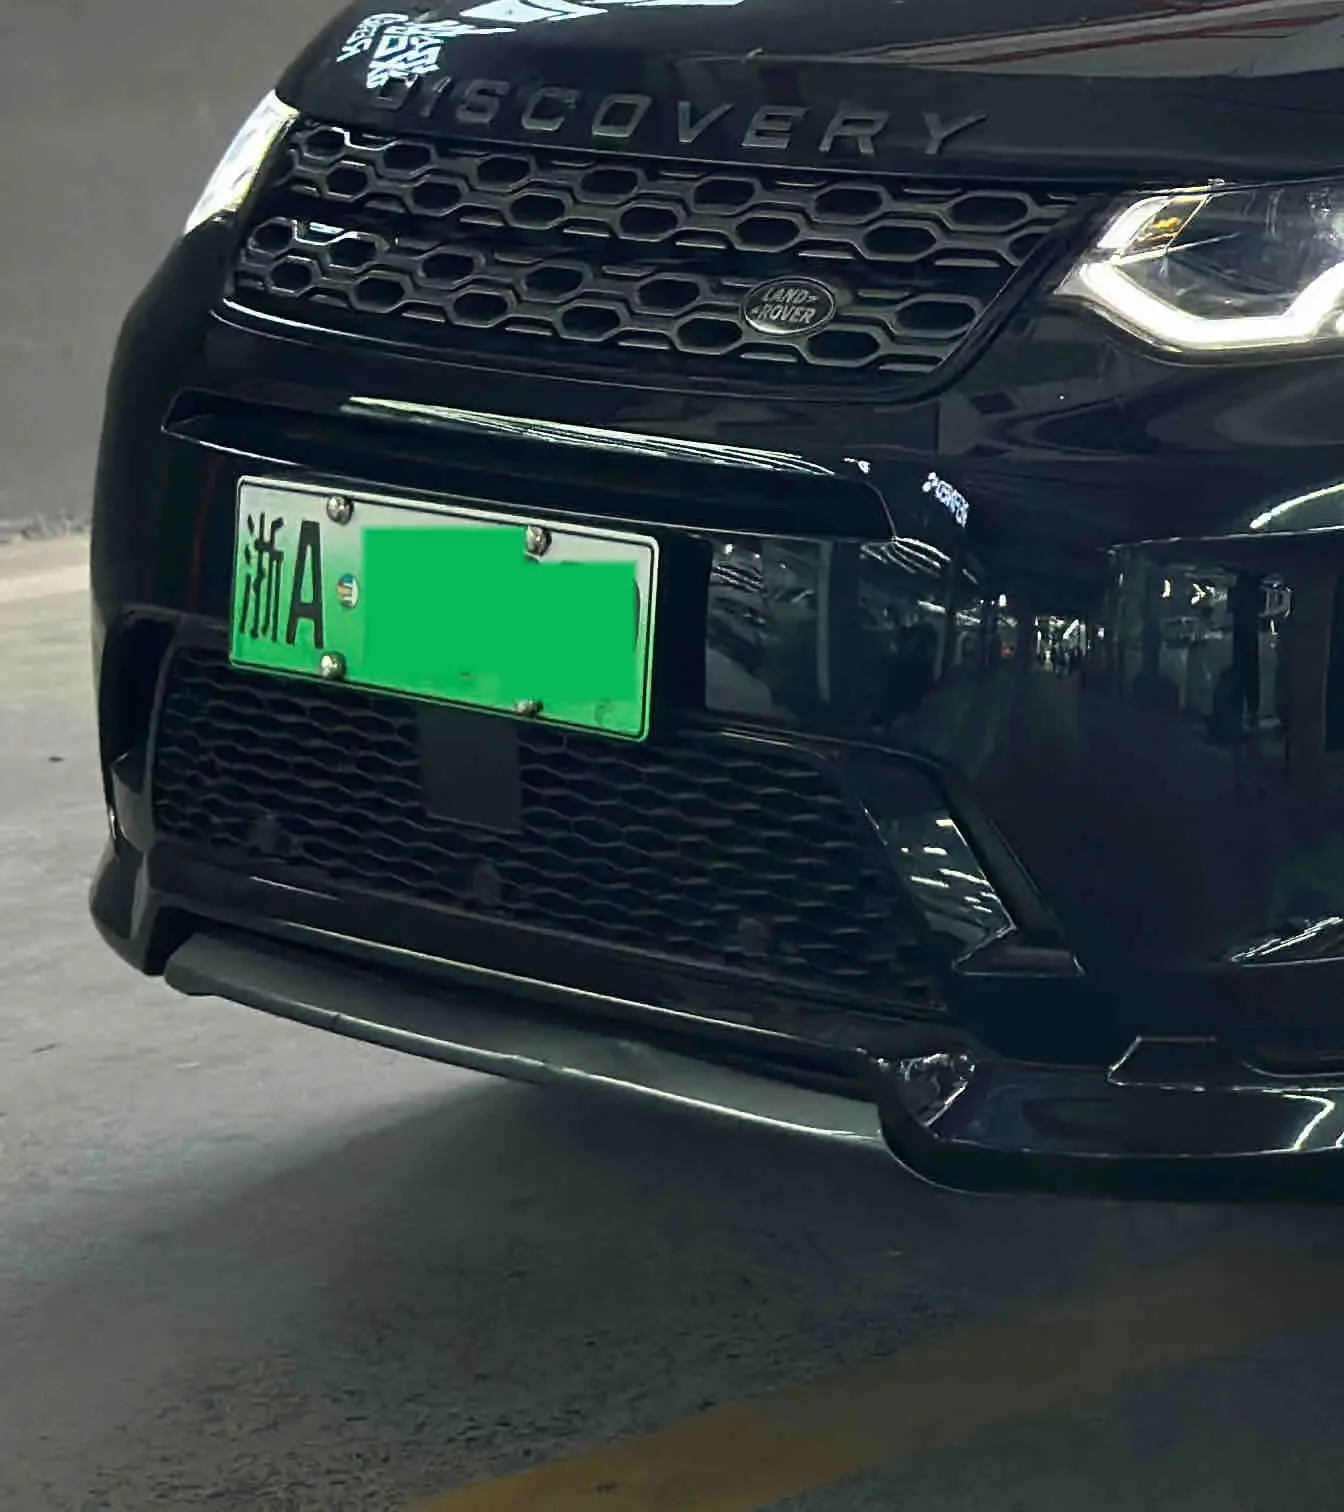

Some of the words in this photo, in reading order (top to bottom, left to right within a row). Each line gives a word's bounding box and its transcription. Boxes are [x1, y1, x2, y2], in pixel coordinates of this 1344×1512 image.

[368, 75, 988, 157] DISCOVERY
[757, 303, 817, 324] ROVER
[762, 287, 810, 305] LAND
[239, 511, 324, 650] 浙A
